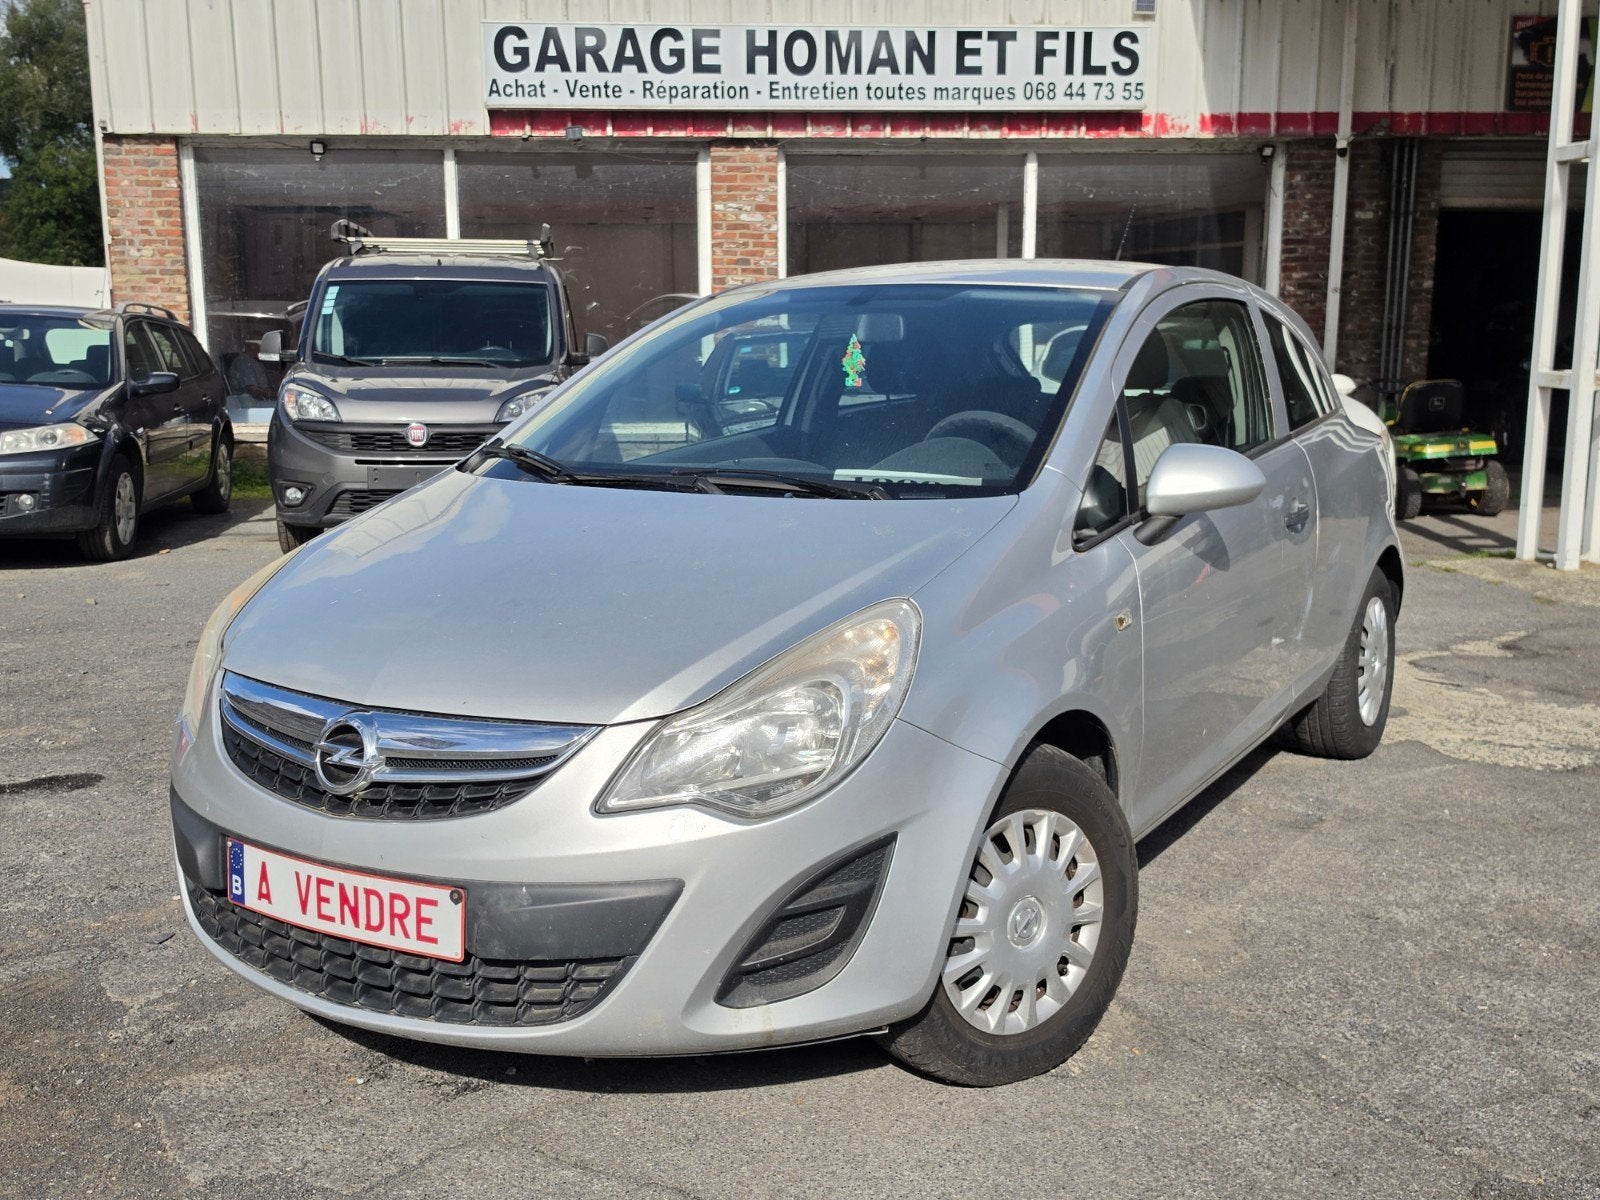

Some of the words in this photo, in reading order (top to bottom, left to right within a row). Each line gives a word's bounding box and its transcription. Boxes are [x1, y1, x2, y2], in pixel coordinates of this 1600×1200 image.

[493, 25, 722, 74] GARAGE
[746, 29, 936, 76] HOMAN
[956, 30, 1018, 76] ET
[1035, 30, 1140, 76] FILS
[488, 78, 546, 98] Achat
[565, 79, 622, 98] Vente
[642, 79, 749, 103] Réparation
[769, 81, 858, 101] Entretien
[866, 82, 926, 101] toutes
[934, 85, 1016, 105] marques
[1023, 82, 1057, 100] 068
[1063, 82, 1086, 100] 44
[1093, 82, 1115, 100] 73
[1122, 82, 1144, 100] 55
[232, 875, 242, 895] B
[257, 861, 273, 905] A
[294, 871, 439, 945] VENDRE
